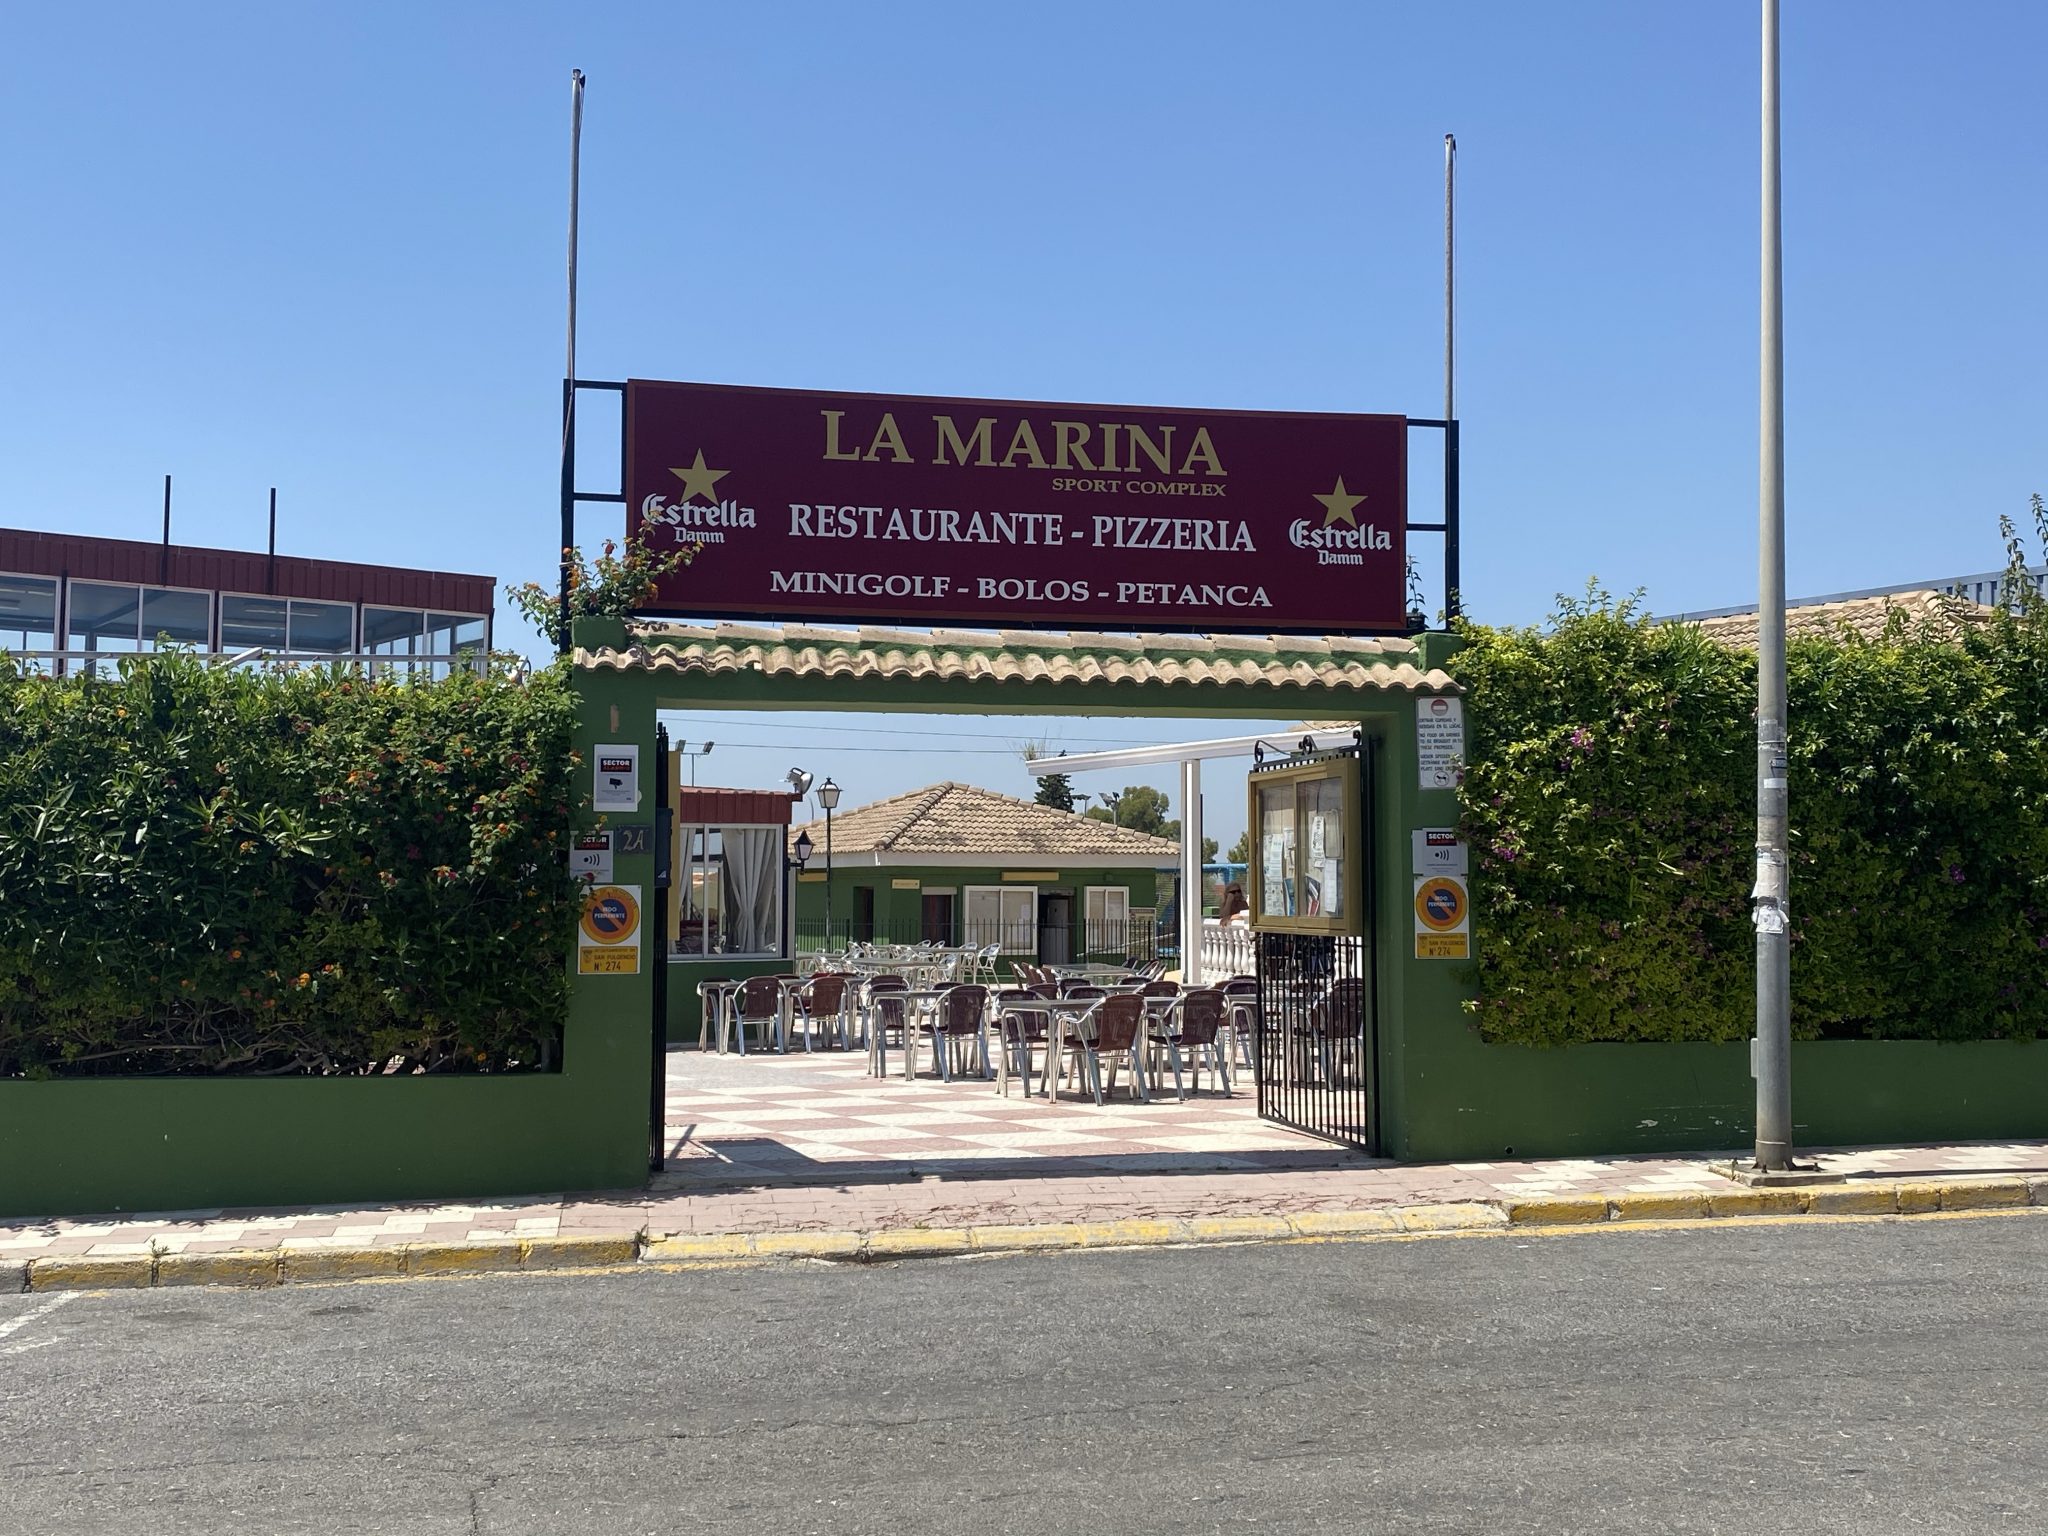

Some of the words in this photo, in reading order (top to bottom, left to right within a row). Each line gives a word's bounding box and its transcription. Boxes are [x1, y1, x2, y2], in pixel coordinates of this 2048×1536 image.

[821, 410, 914, 463] LA
[932, 415, 1228, 476] MARINA
[1052, 478, 1121, 493] SPORT
[1126, 481, 1226, 497] COMPLEX
[642, 493, 757, 528] Estrella
[673, 526, 725, 544] Damm
[788, 504, 1063, 546] RESTAURANTE
[1092, 515, 1257, 552] PIZZERIA
[1289, 518, 1392, 550] Estrella
[1317, 549, 1363, 565] Damm
[770, 571, 950, 597] MINIGOLF
[977, 578, 1090, 601] BOLOS
[1116, 582, 1273, 607] PETANCA
[623, 830, 644, 851] 2A
[1437, 947, 1450, 956] 274
[606, 961, 621, 971] 274
